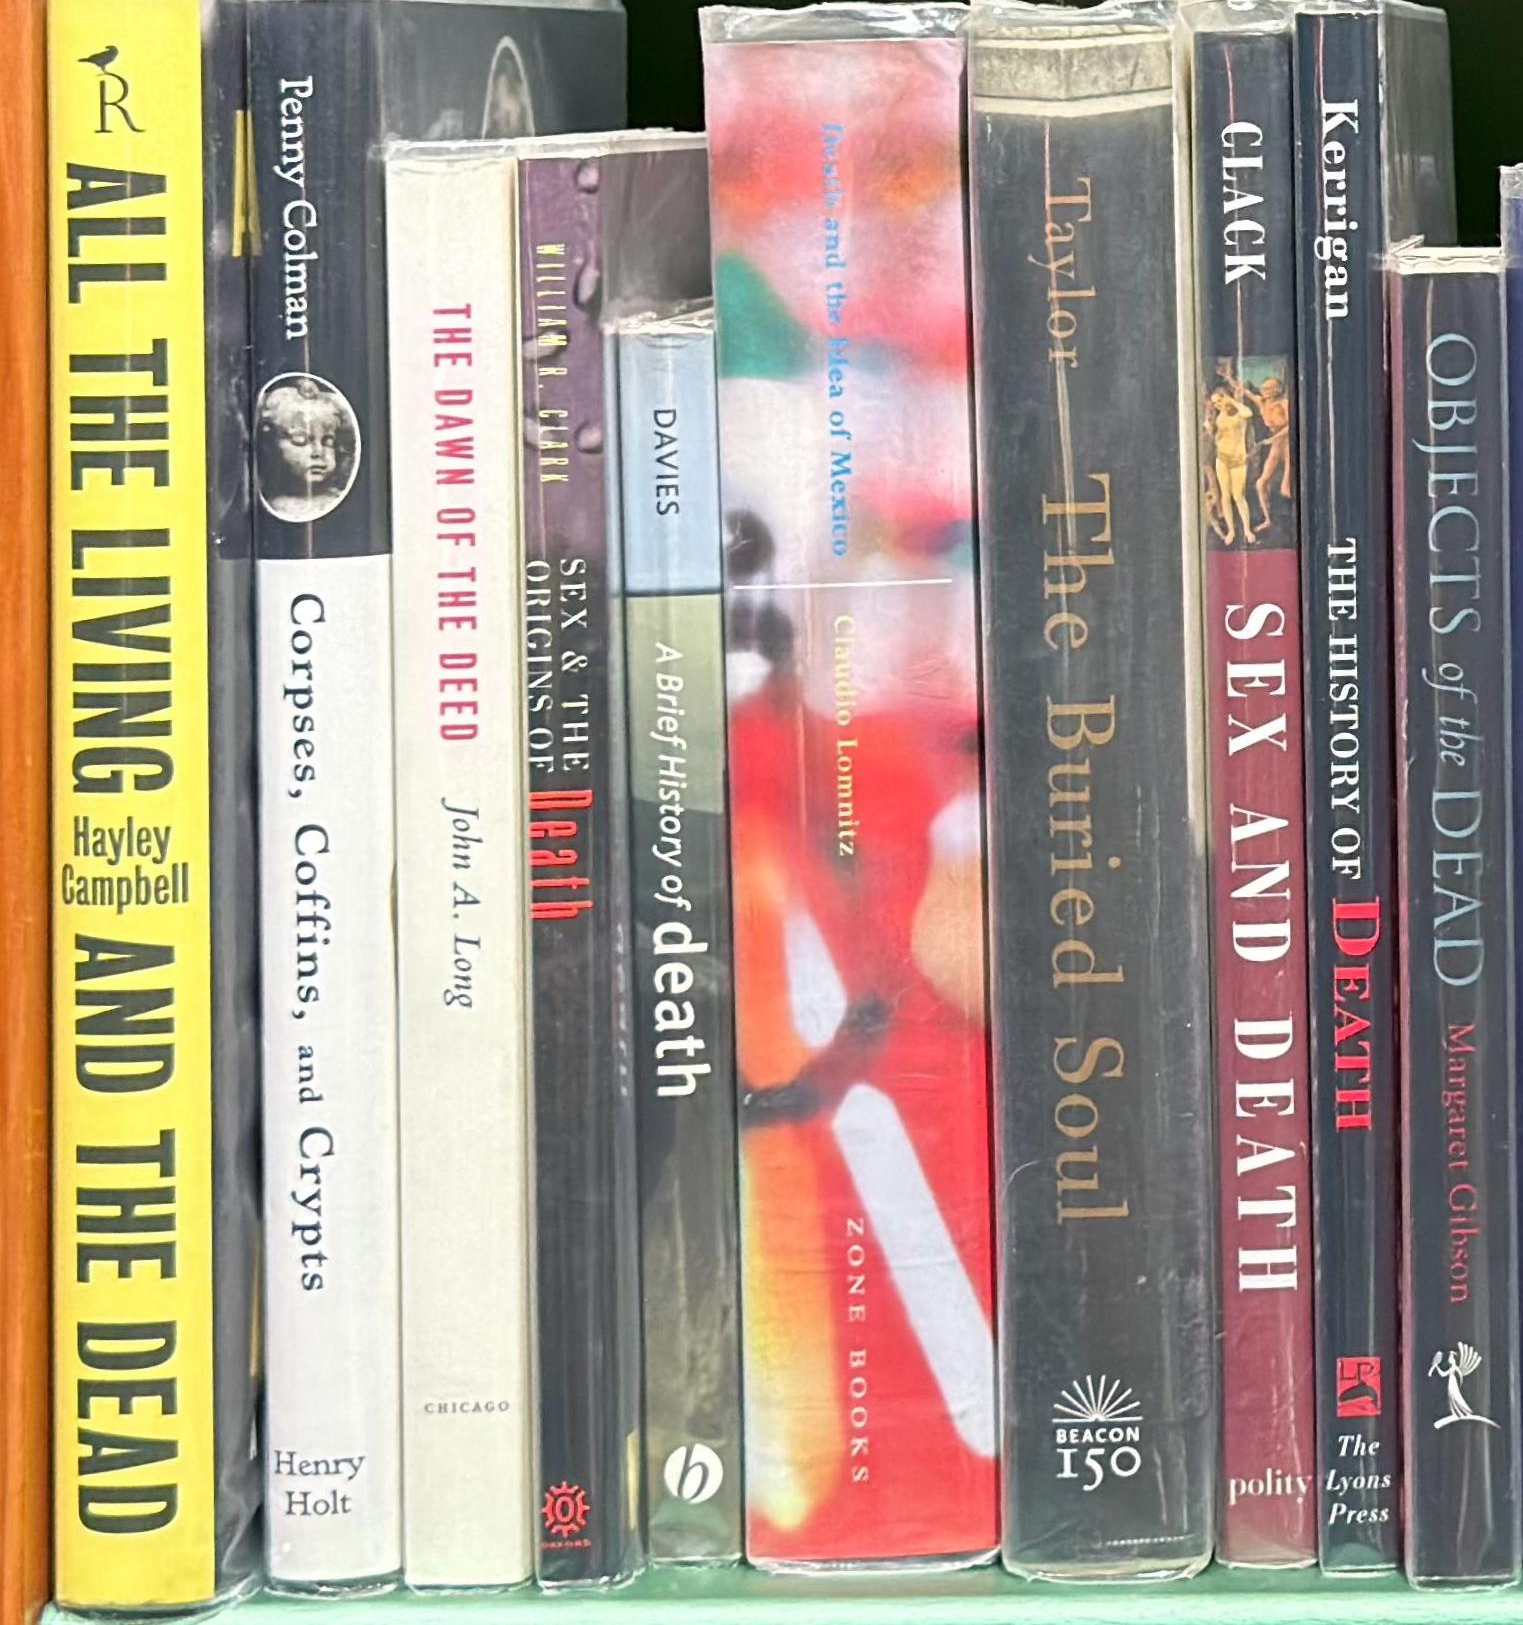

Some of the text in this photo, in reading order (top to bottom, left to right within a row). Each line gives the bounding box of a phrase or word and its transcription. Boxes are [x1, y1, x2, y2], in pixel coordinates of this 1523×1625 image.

[273, 76, 318, 340] Penny Colman
[824, 216, 845, 269] and
[1027, 176, 1097, 368] Taylor
[1221, 121, 1267, 285] CLACK
[1313, 98, 1359, 320] Kerrigan
[536, 243, 569, 482] WILLIAM R. CLARK
[826, 277, 848, 324] the
[827, 335, 851, 398] Idea
[432, 303, 478, 741] THE DAWN OF THE DEED
[653, 408, 680, 516] DAVIES
[828, 410, 852, 442] of
[829, 451, 853, 557] Mexico
[525, 560, 593, 920] ORIGINS OF Death
[559, 558, 590, 771] SEX & THE
[832, 615, 858, 857] Claudio Lomnitz
[1412, 332, 1486, 988] OBJECTS of the DEAD
[61, 815, 190, 914] Hayley Campbell
[65, 162, 180, 1533] ALL THE LIVING AND THE DEAD
[441, 798, 484, 1010] John A. Long
[650, 641, 711, 1098] A Brief History of death
[1041, 472, 1130, 1226] The Buried Soul
[1327, 537, 1382, 1131] THE HISTORY OF DEATH
[283, 593, 336, 1292] Corpses, Coffins, and Crypts
[1224, 603, 1298, 1292] SEX AND DEATH
[1440, 1022, 1485, 1306] Margaret Gibson
[424, 1400, 511, 1414] CHICAGO
[846, 1217, 869, 1483] ZONE BOOKS
[1055, 1427, 1141, 1443] BEACON
[1338, 1434, 1380, 1457] The
[273, 1449, 366, 1483] Henry
[285, 1487, 351, 1518] Holt
[1056, 1447, 1142, 1491] 150
[1229, 1470, 1313, 1510] polity
[1326, 1469, 1391, 1496] Lyons
[1328, 1503, 1390, 1526] Press
